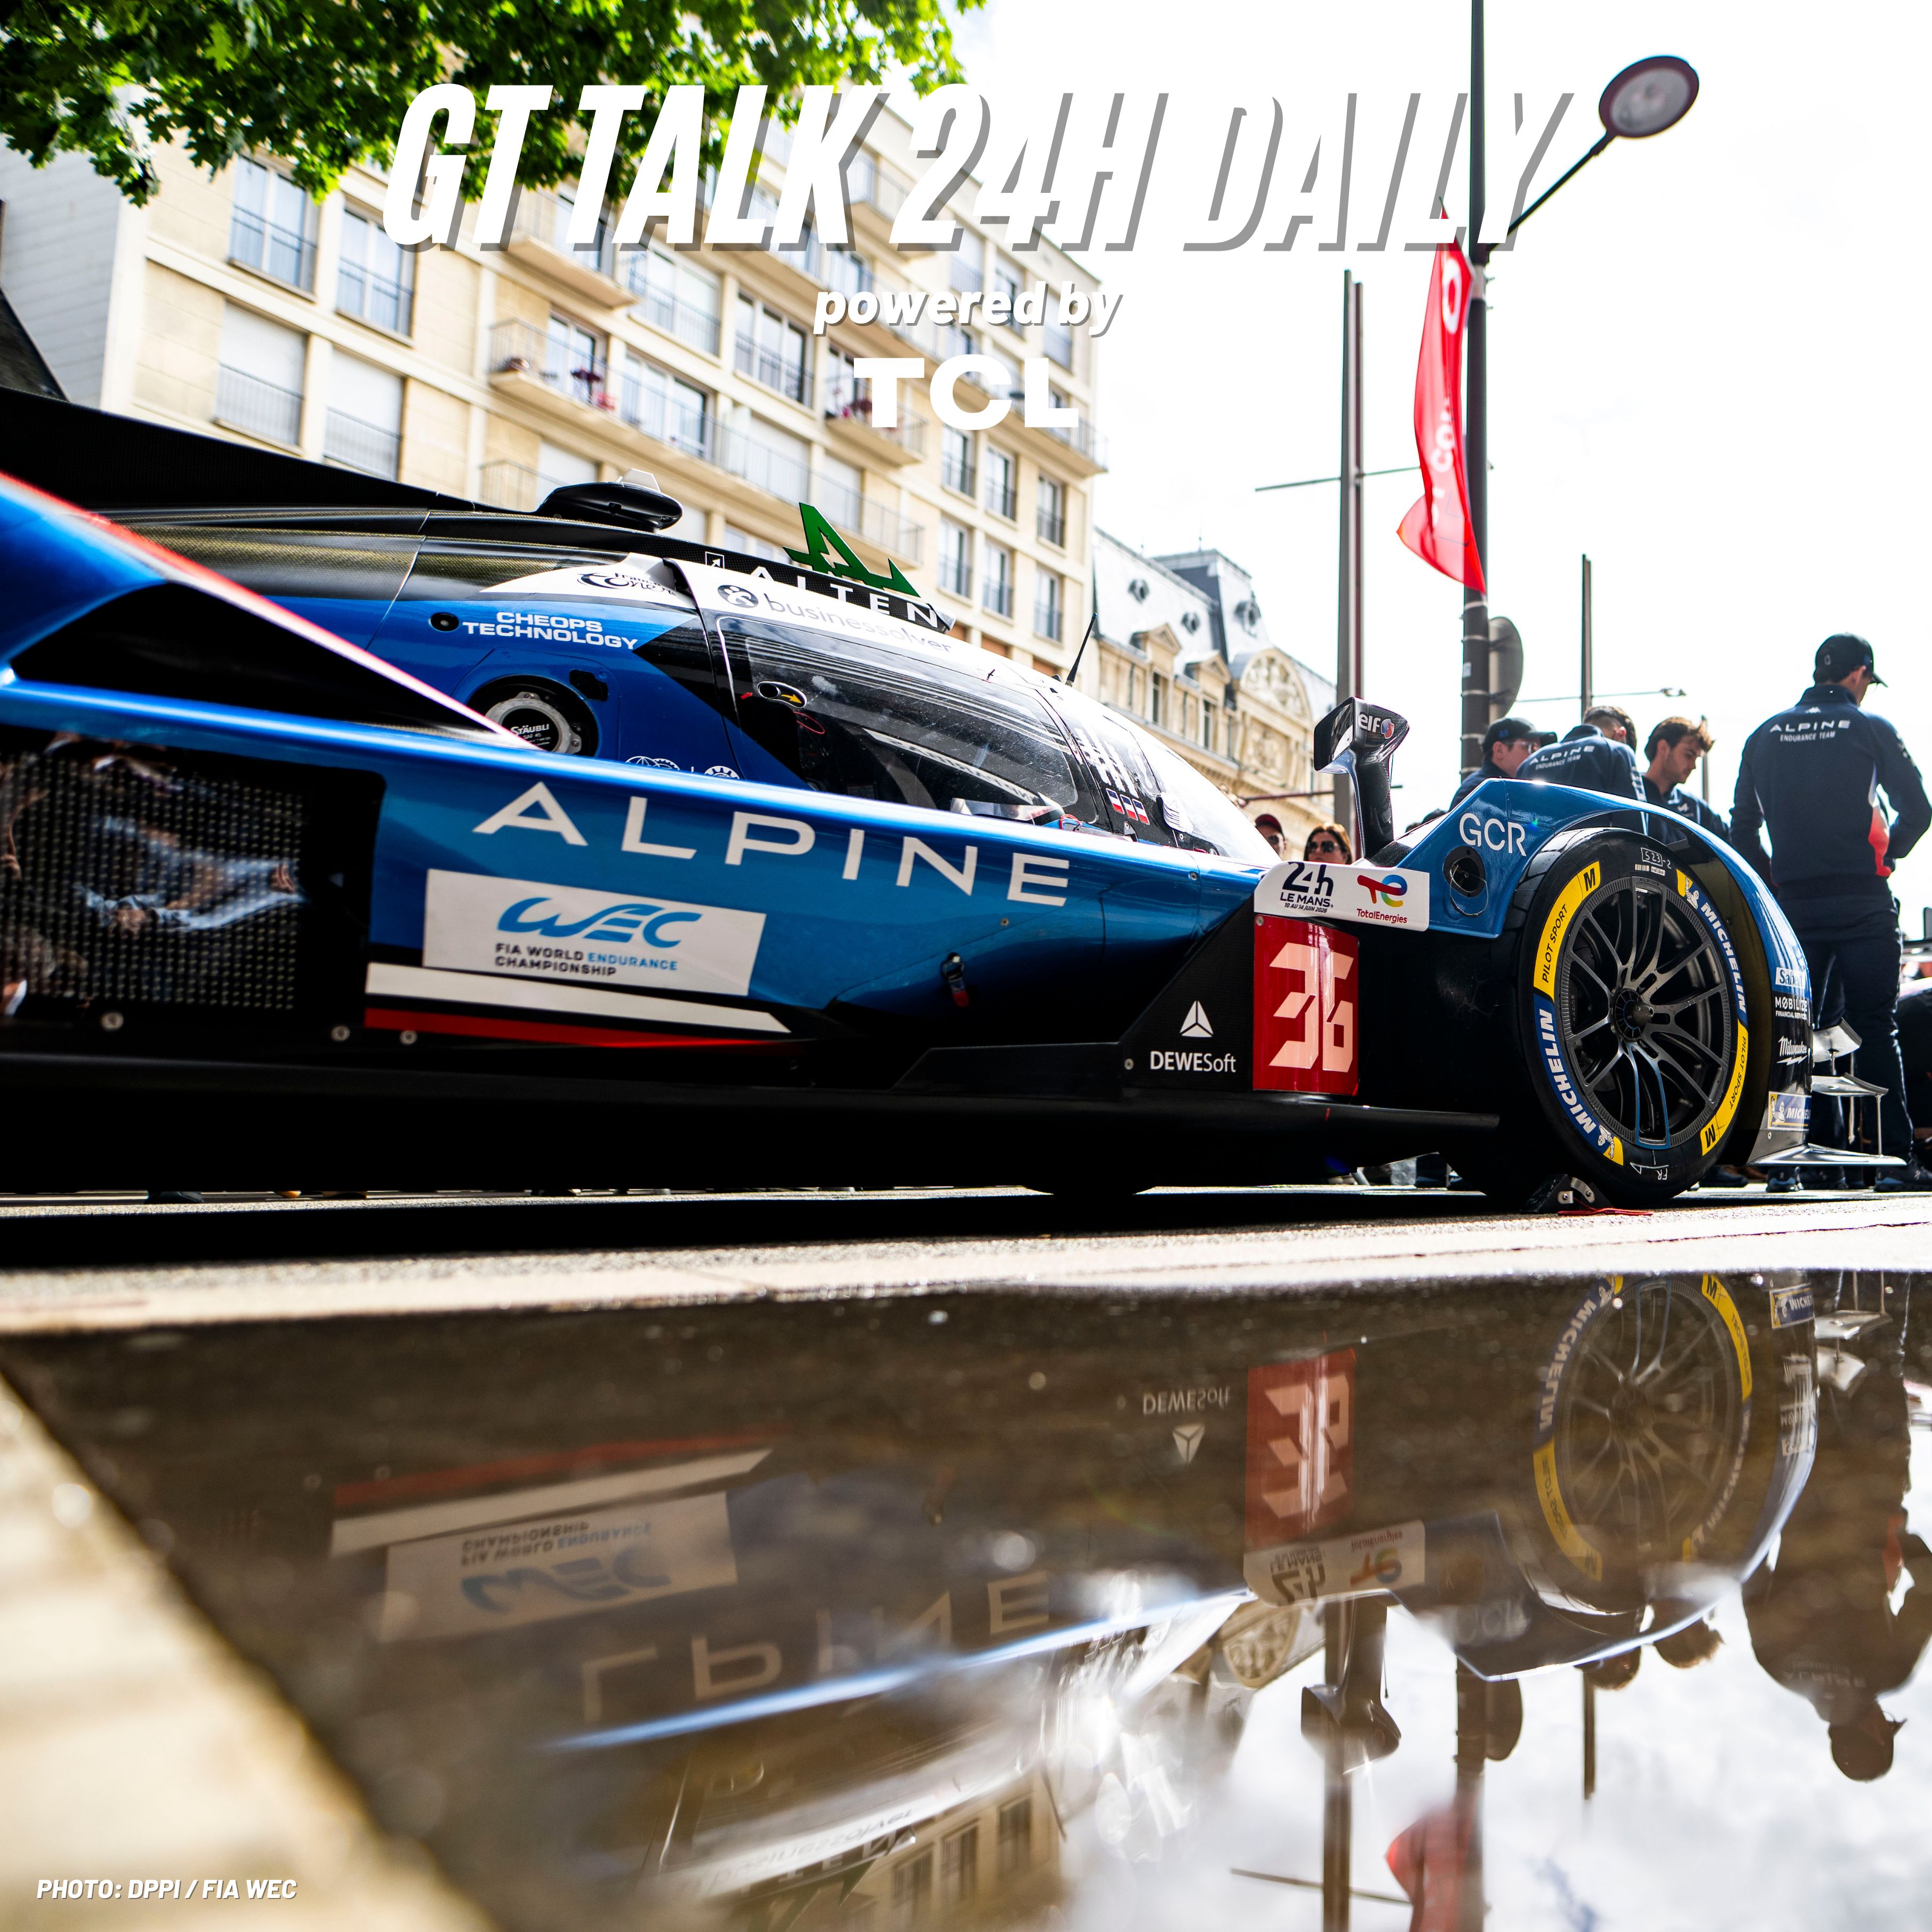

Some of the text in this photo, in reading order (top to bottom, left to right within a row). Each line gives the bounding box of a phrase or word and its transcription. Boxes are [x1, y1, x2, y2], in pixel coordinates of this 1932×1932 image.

[496, 612, 603, 632] CHEOPS
[764, 593, 952, 654] businessolver
[462, 622, 639, 650] TECHNOLOGY
[510, 723, 550, 736] STÄUBLI
[1358, 712, 1381, 733] elf
[1769, 719, 1851, 733] ALPINE
[1780, 731, 1836, 742] ENDURANCE TEAM
[1529, 745, 1595, 765] ALPINE
[472, 781, 1070, 906] ALPINE
[1459, 812, 1527, 857] GCR
[1282, 861, 1334, 897] 24h
[1583, 867, 1596, 892] M
[1279, 892, 1331, 908] LE MANS
[497, 897, 702, 948] WEC
[1357, 908, 1408, 924] TotalEnergies
[1542, 903, 1568, 983] PILOT SPORT
[495, 943, 678, 971] FIA WORLD ENDURANCE
[495, 956, 617, 977] CHAMPIONSHIP
[1701, 902, 1747, 1014] MICHELIN
[1269, 942, 1354, 1073] 36
[1149, 1050, 1236, 1073] DEWESoft
[1539, 1009, 1597, 1134] MICHELIN
[1729, 1072, 1743, 1110] SPORT
[1656, 1167, 1668, 1181] FR
